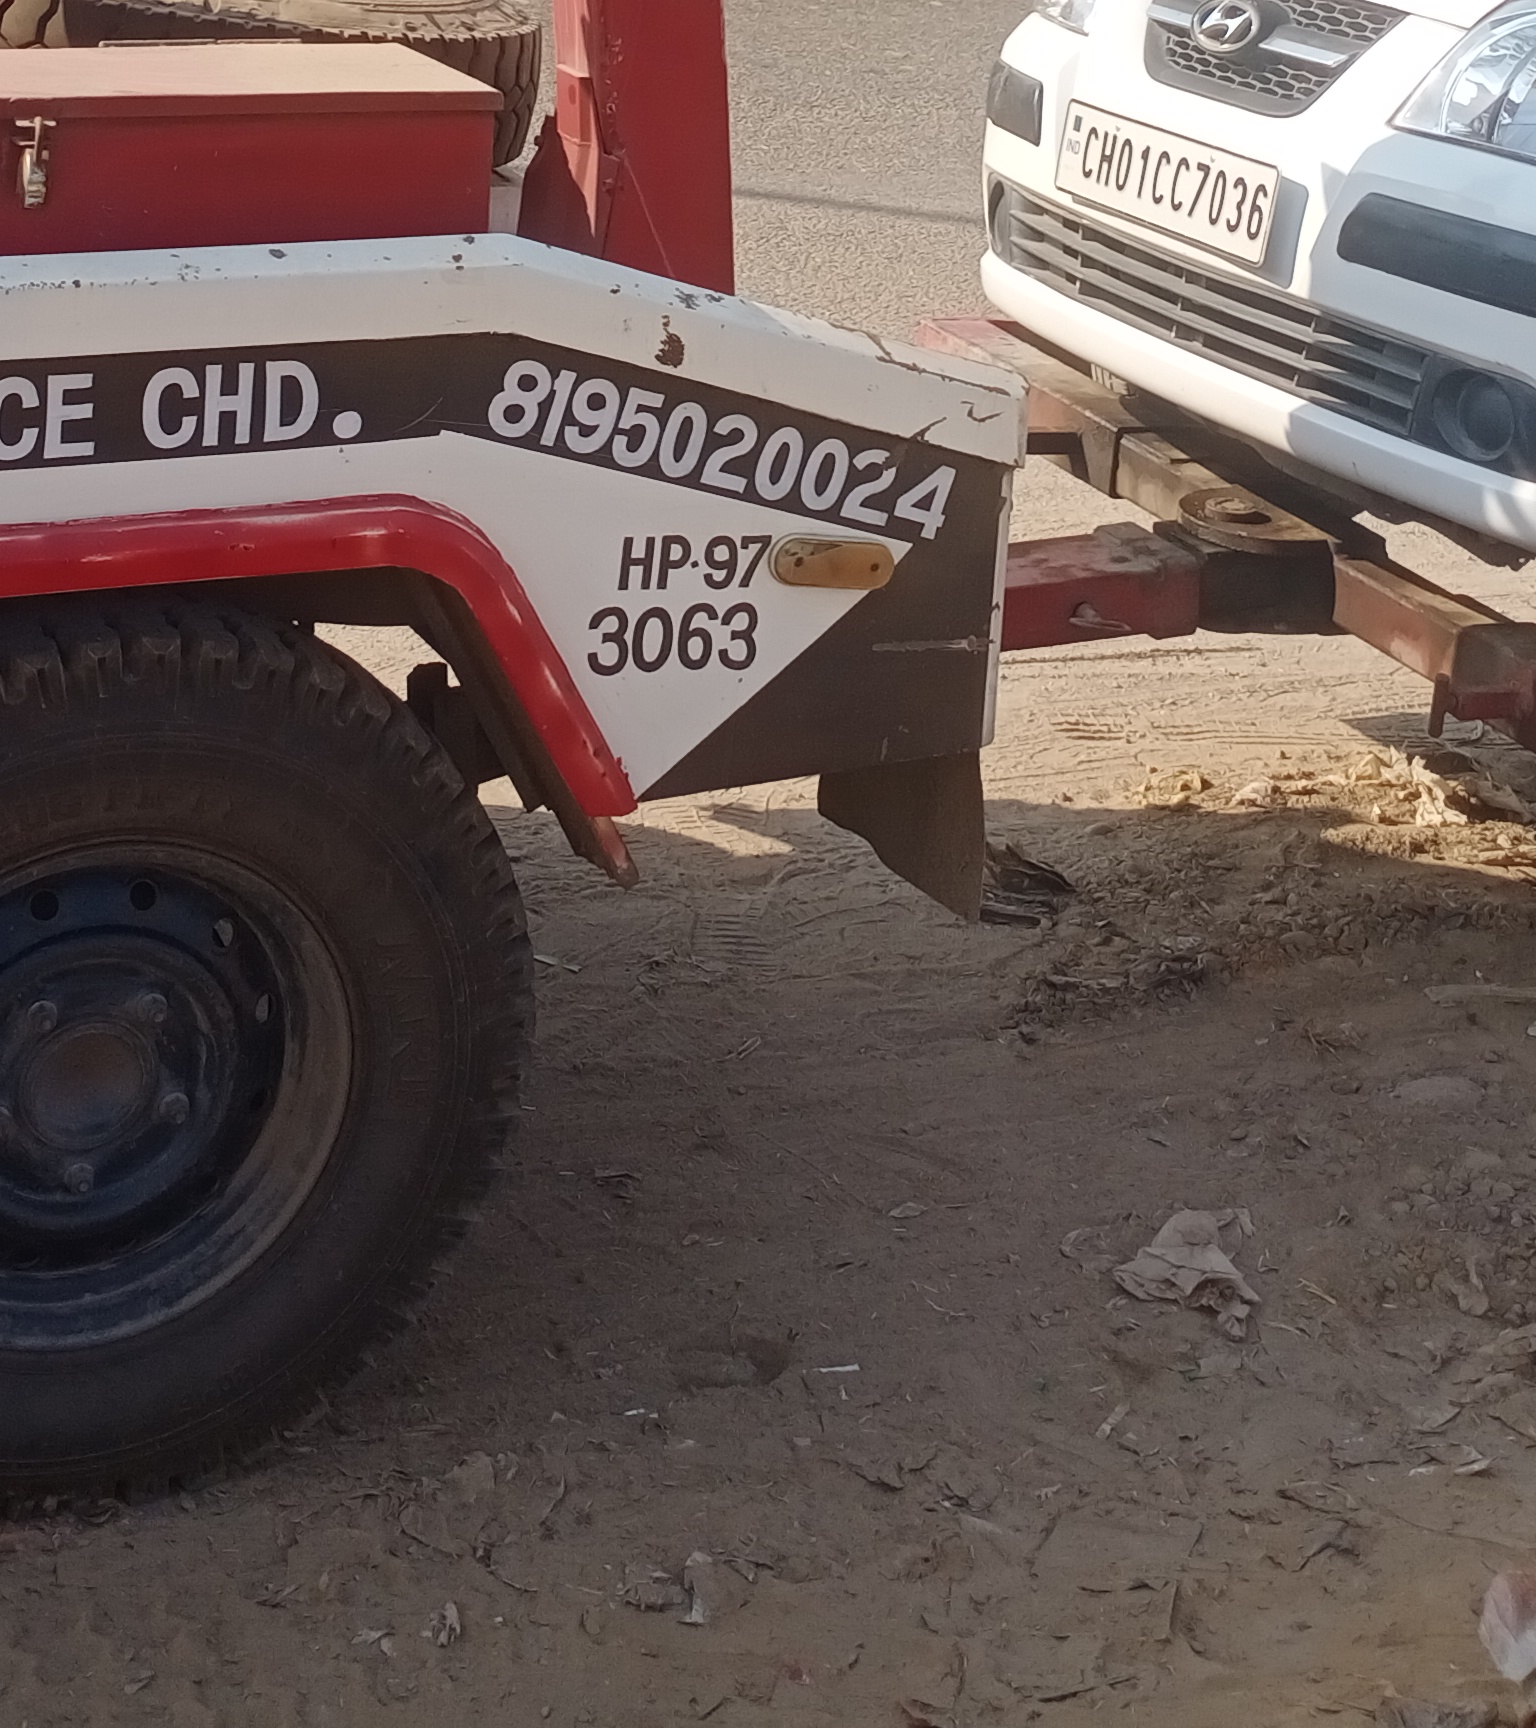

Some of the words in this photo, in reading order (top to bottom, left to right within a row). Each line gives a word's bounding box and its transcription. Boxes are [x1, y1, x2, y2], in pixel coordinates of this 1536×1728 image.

[1082, 127, 1268, 240] CH01CC7036
[140, 360, 364, 450] CHD.
[487, 359, 957, 541] 8195020024
[587, 602, 759, 676] 3063
